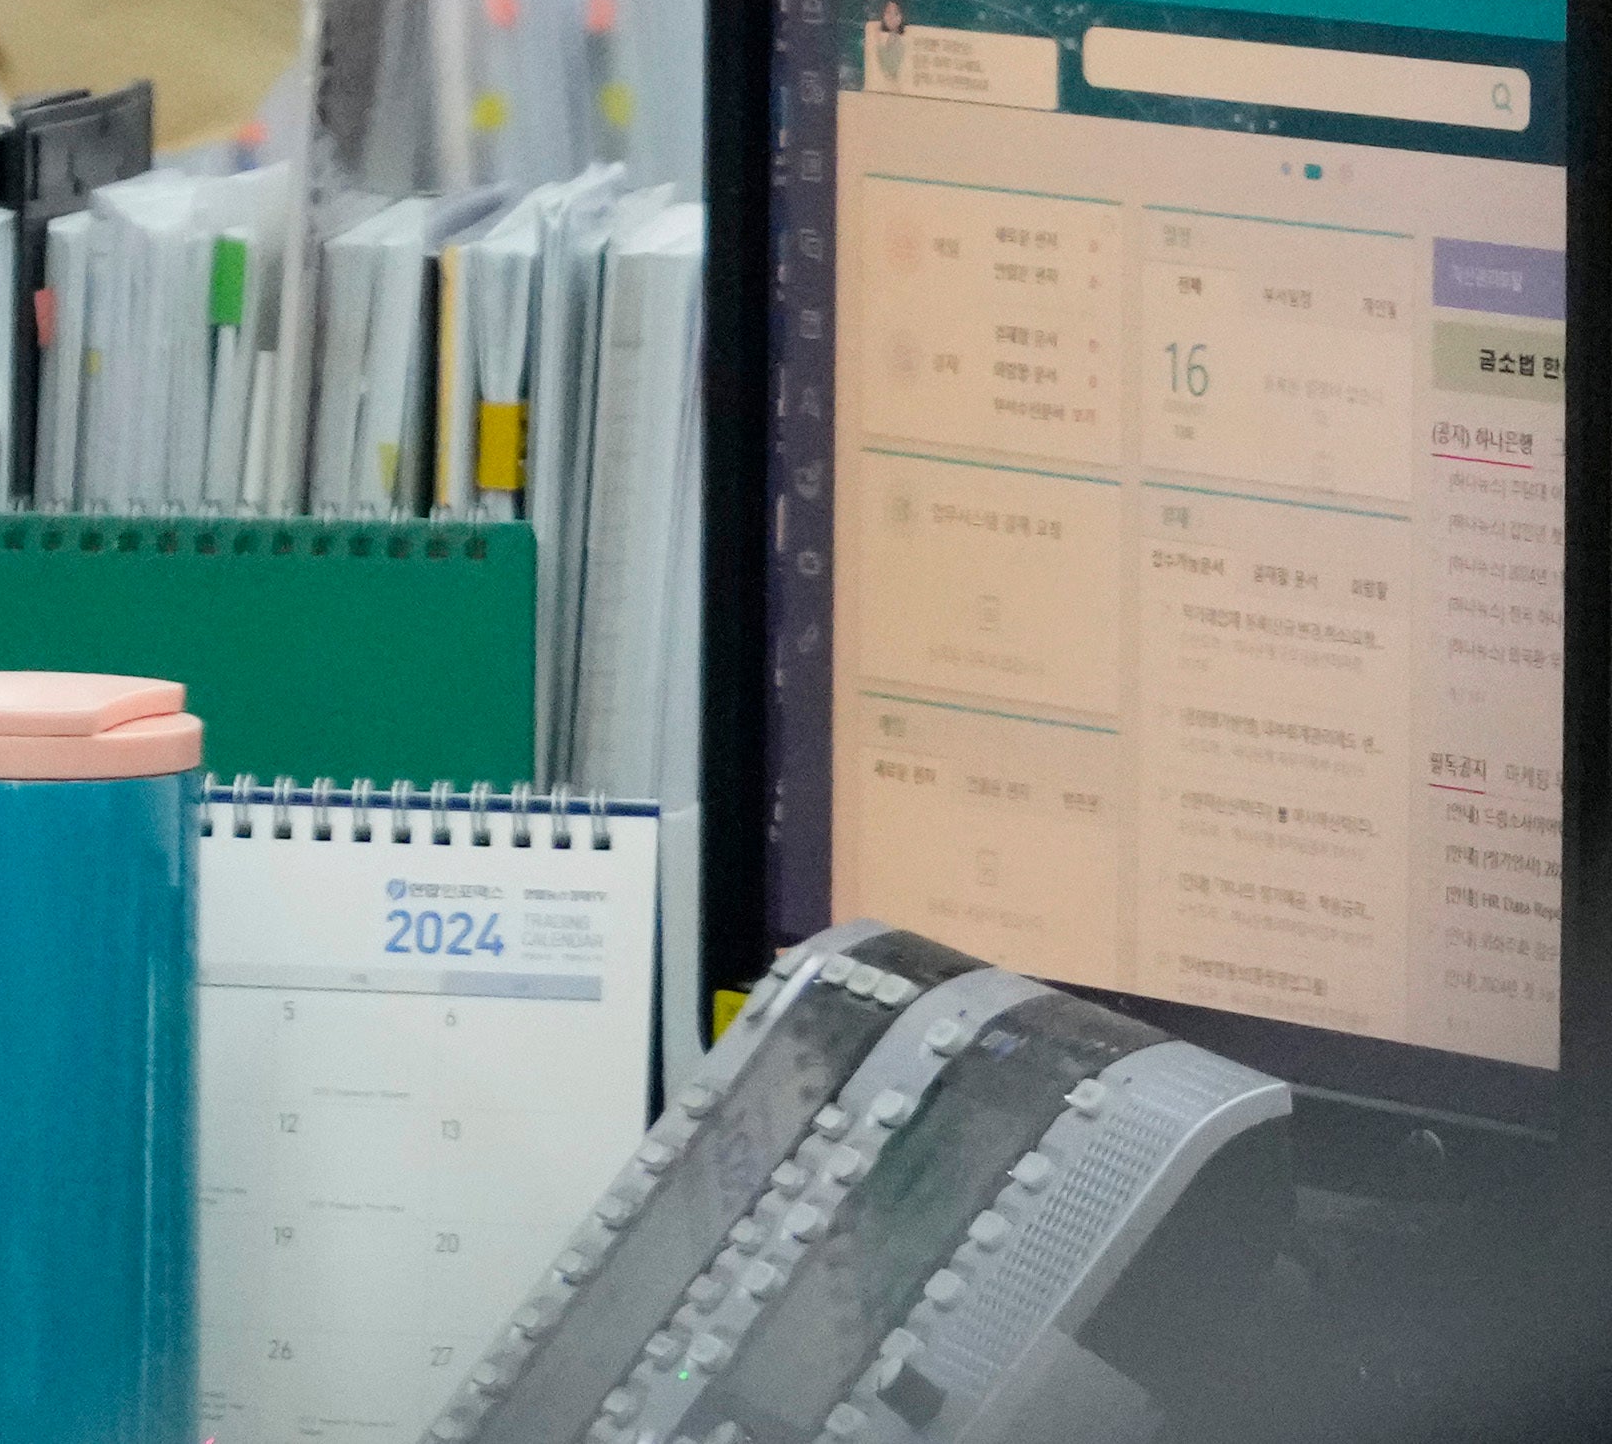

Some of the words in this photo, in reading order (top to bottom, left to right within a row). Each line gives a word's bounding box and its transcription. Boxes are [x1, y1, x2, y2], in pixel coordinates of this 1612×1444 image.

[1165, 342, 1208, 396] 16
[1480, 348, 1535, 376] 금소법
[1543, 357, 1565, 379] 한
[1475, 427, 1533, 455] 하나은행
[385, 909, 504, 957] 2024
[283, 1001, 294, 1021] 5
[445, 1009, 457, 1027] 6
[278, 1113, 299, 1133] 12
[441, 1120, 460, 1139] 13
[273, 1226, 294, 1244] 19
[435, 1233, 460, 1253] 20
[268, 1341, 293, 1360] 26
[430, 1347, 454, 1366] 27
